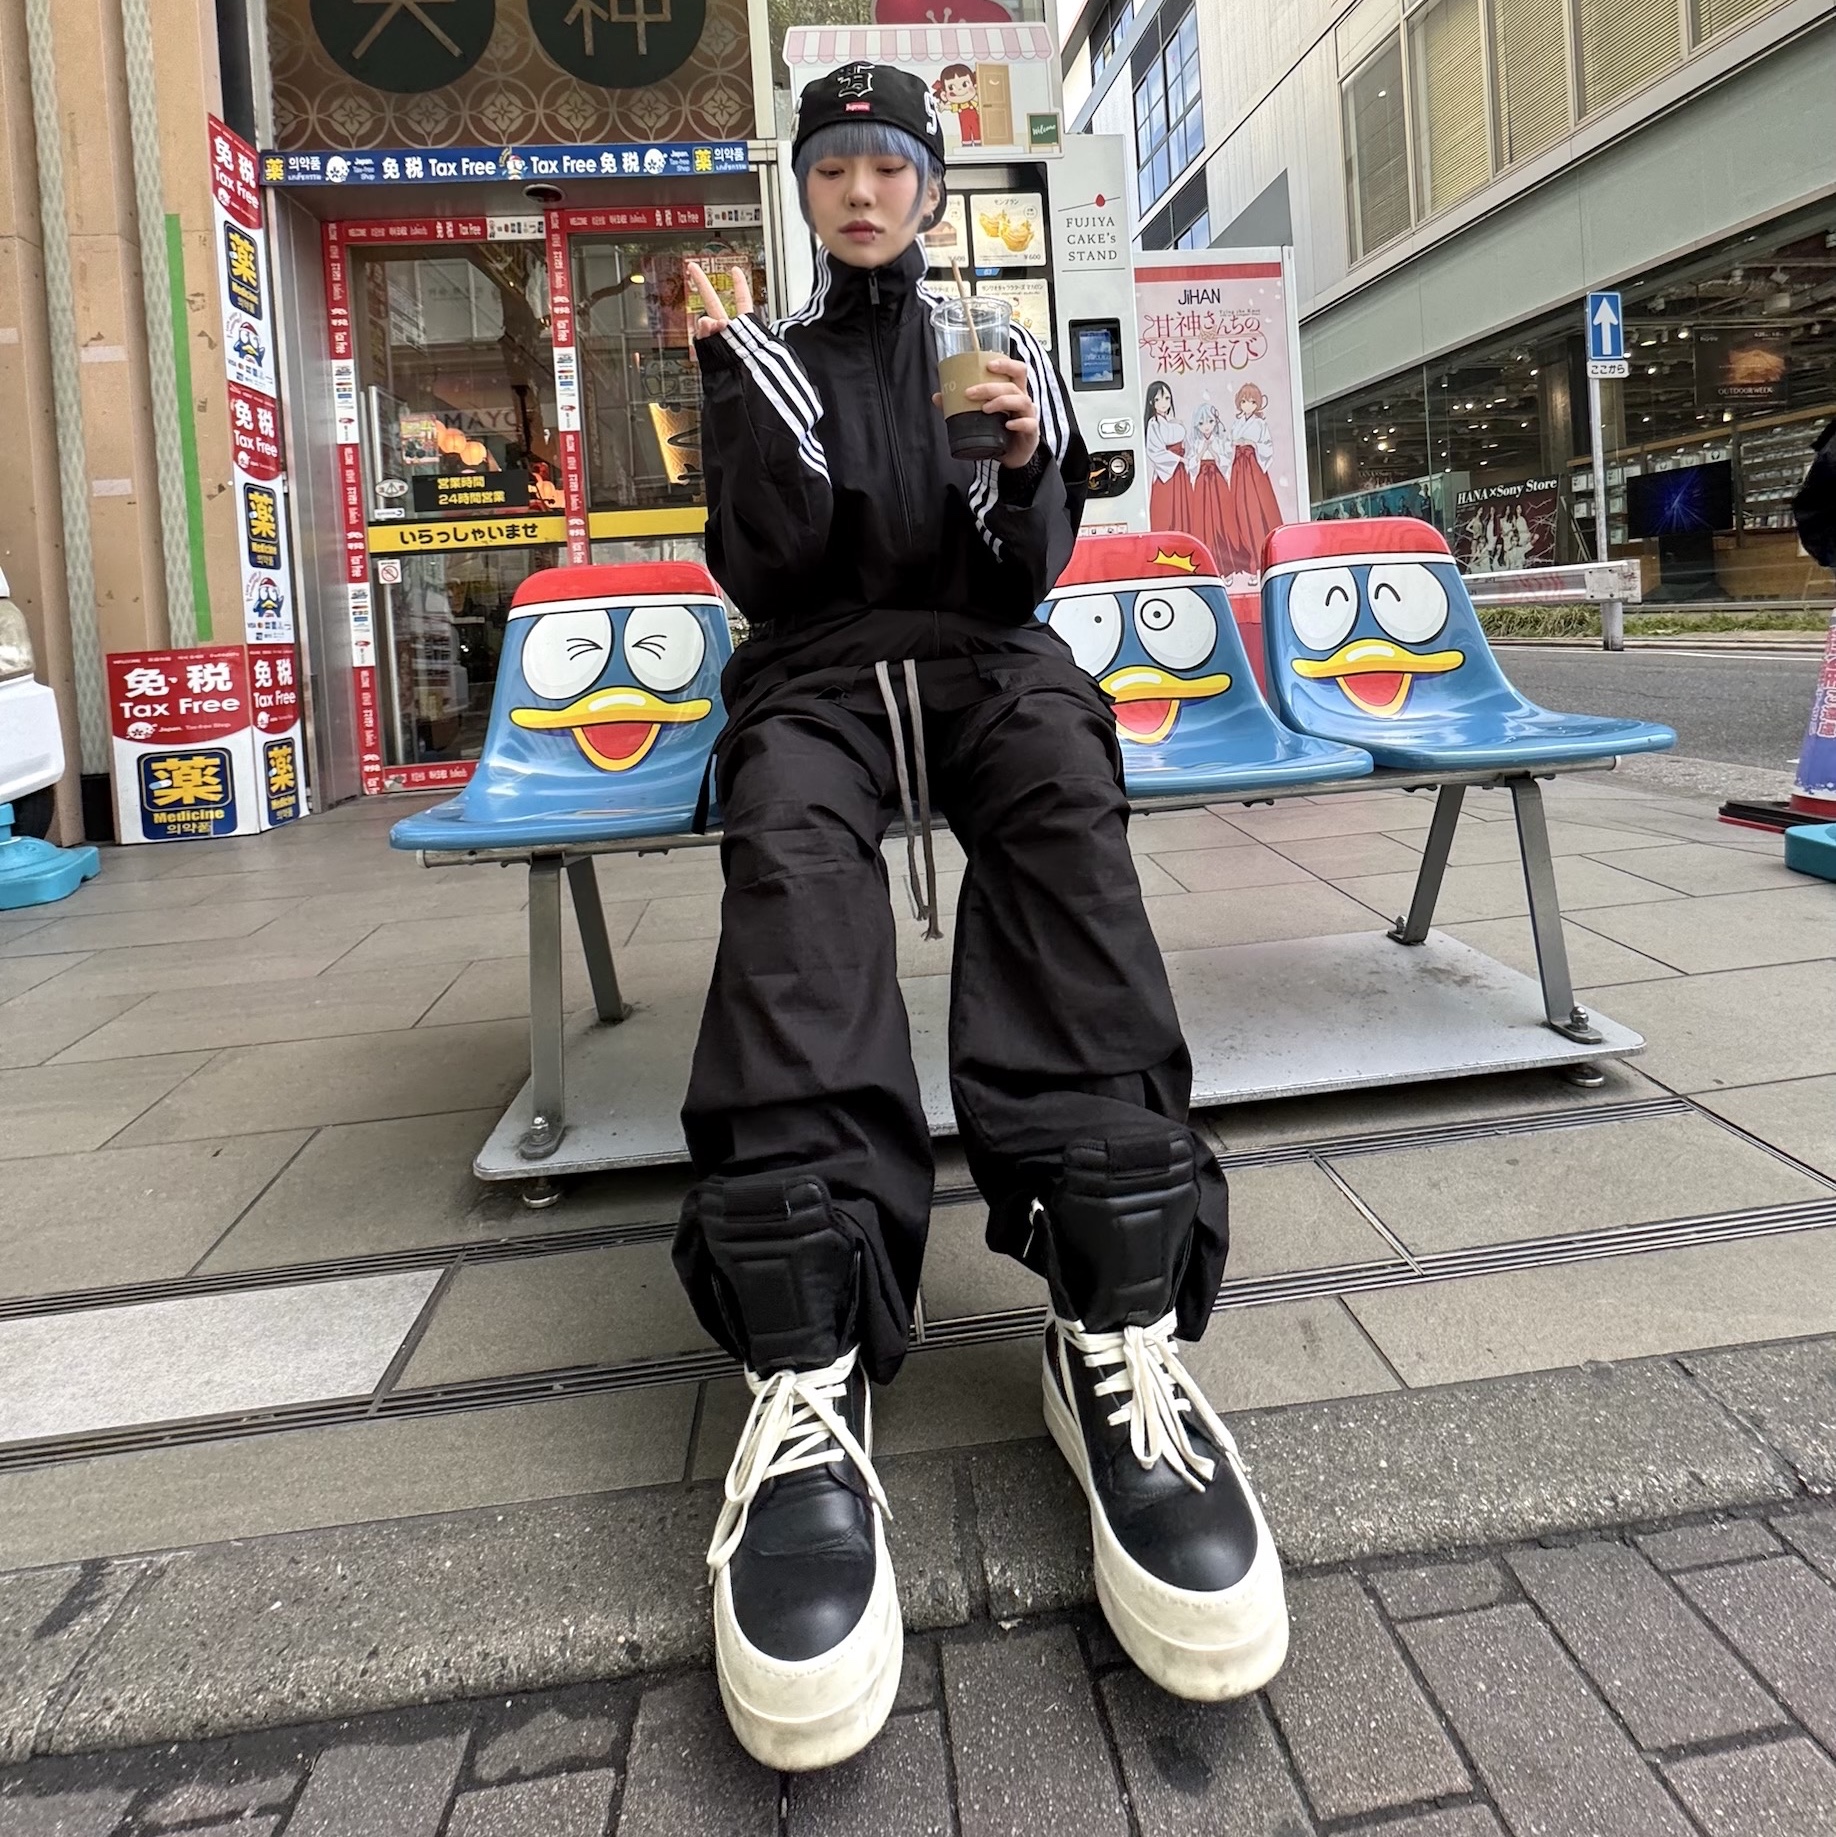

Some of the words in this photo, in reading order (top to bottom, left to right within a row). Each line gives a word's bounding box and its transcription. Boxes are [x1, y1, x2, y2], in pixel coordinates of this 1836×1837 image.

[1032, 125, 1056, 136] Welcome
[214, 135, 256, 189] 免税
[288, 156, 321, 171] 의약품
[530, 156, 559, 174] Tax
[563, 155, 596, 173] Free
[600, 151, 640, 174] 免税
[694, 149, 712, 171] 薬
[714, 147, 744, 162] 의약품
[265, 158, 284, 181] 薬
[382, 156, 424, 180] 免税
[429, 158, 458, 177] Tax
[462, 157, 497, 176] Free
[213, 163, 235, 192] Tax
[236, 180, 259, 209] Free
[1066, 216, 1115, 228] FUJIYA
[1067, 232, 1117, 245] CAKE's
[228, 231, 258, 287] 薬
[1023, 253, 1042, 261] ¥600
[1068, 249, 1118, 261] STAND
[1154, 310, 1260, 338] 甘神さんちの
[1157, 338, 1259, 375] 縁結び
[1591, 364, 1626, 375] ここから
[234, 399, 275, 438] 免税
[234, 430, 255, 451] Tax
[256, 437, 278, 458] Free
[437, 475, 485, 490] 営業時間
[1525, 479, 1558, 493] Store
[438, 491, 505, 506] 24時間営業
[248, 491, 276, 538] 薬
[400, 523, 538, 544] いらっしゃいませ
[253, 658, 294, 689] 免税
[119, 702, 170, 719] Tax
[179, 697, 241, 715] Free
[253, 692, 274, 709] Tax
[275, 690, 297, 706] Free
[151, 755, 224, 806] 薬
[268, 745, 297, 794] 薬
[153, 808, 226, 824] Medicine
[166, 822, 213, 836] 의약품
